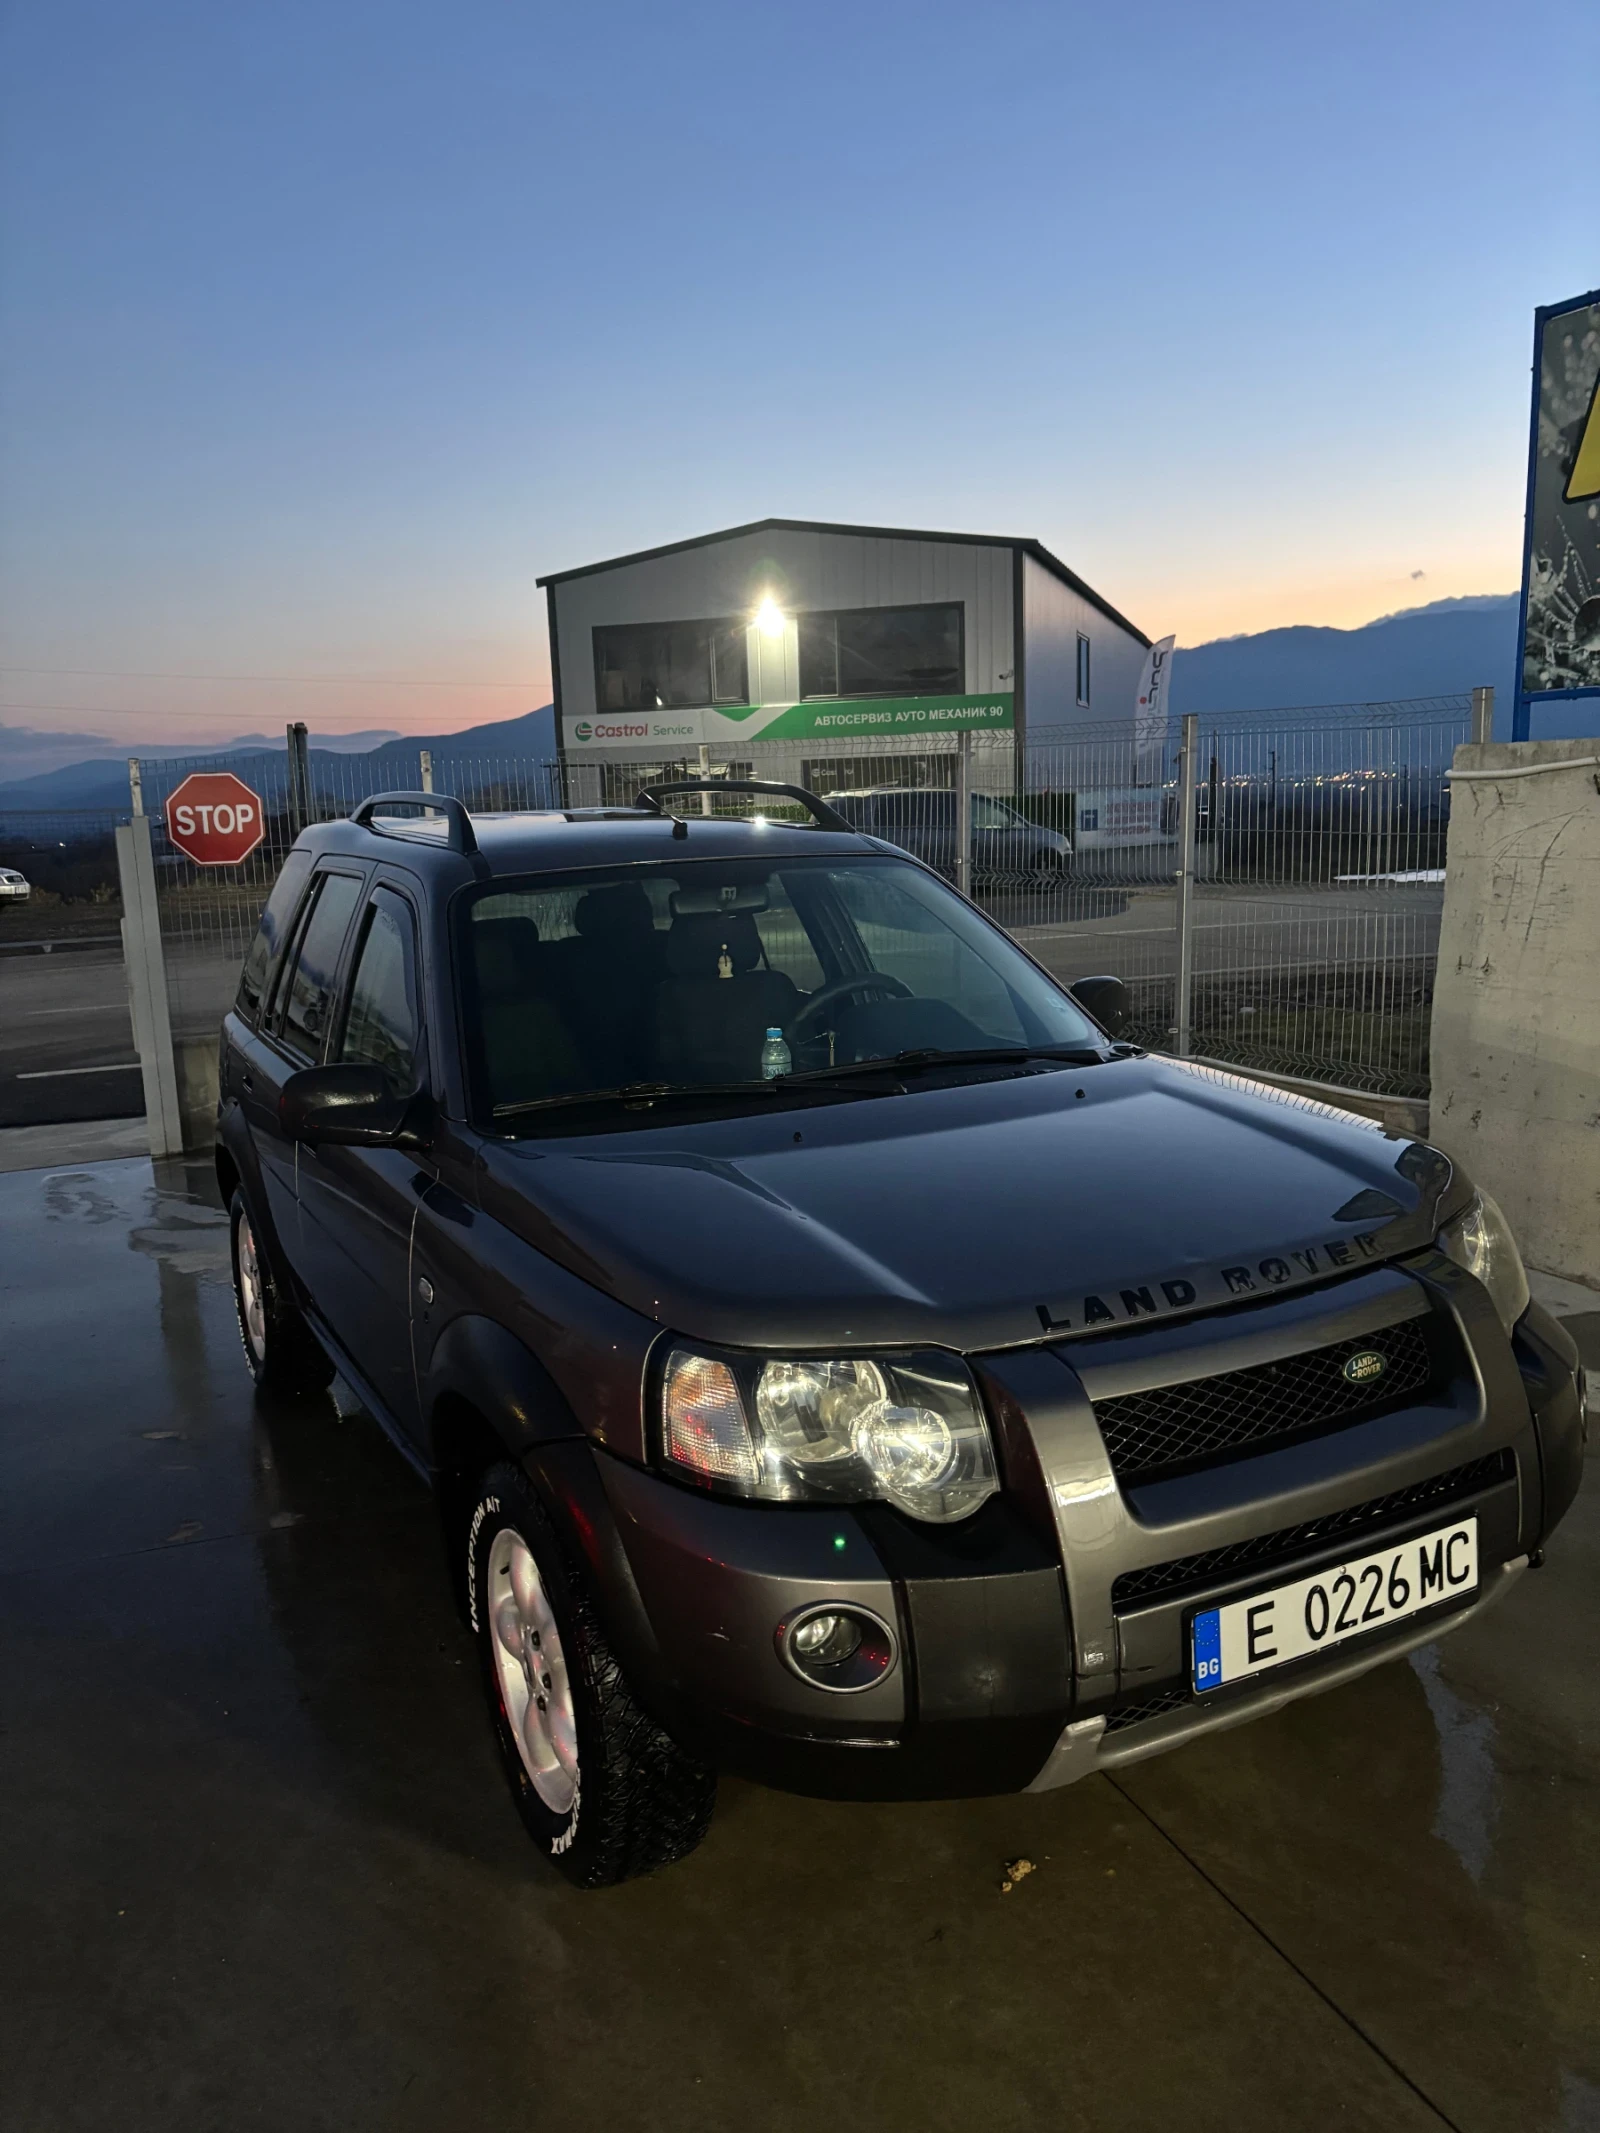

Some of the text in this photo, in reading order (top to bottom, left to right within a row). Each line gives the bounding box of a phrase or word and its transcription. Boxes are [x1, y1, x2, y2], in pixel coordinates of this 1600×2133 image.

[814, 705, 1004, 727] АВТОСЕРВИЗ АУТО МЕХАНИК 90
[595, 723, 694, 738] Castrol Service
[175, 804, 254, 836] STOP
[1035, 1232, 1384, 1333] LAND ROVER
[1352, 1355, 1373, 1370] LAND
[1357, 1362, 1381, 1379] ROVER
[468, 1495, 500, 1633] INCEPTION A/T
[1247, 1530, 1470, 1665] E 0226 MC
[1198, 1657, 1220, 1680] BG
